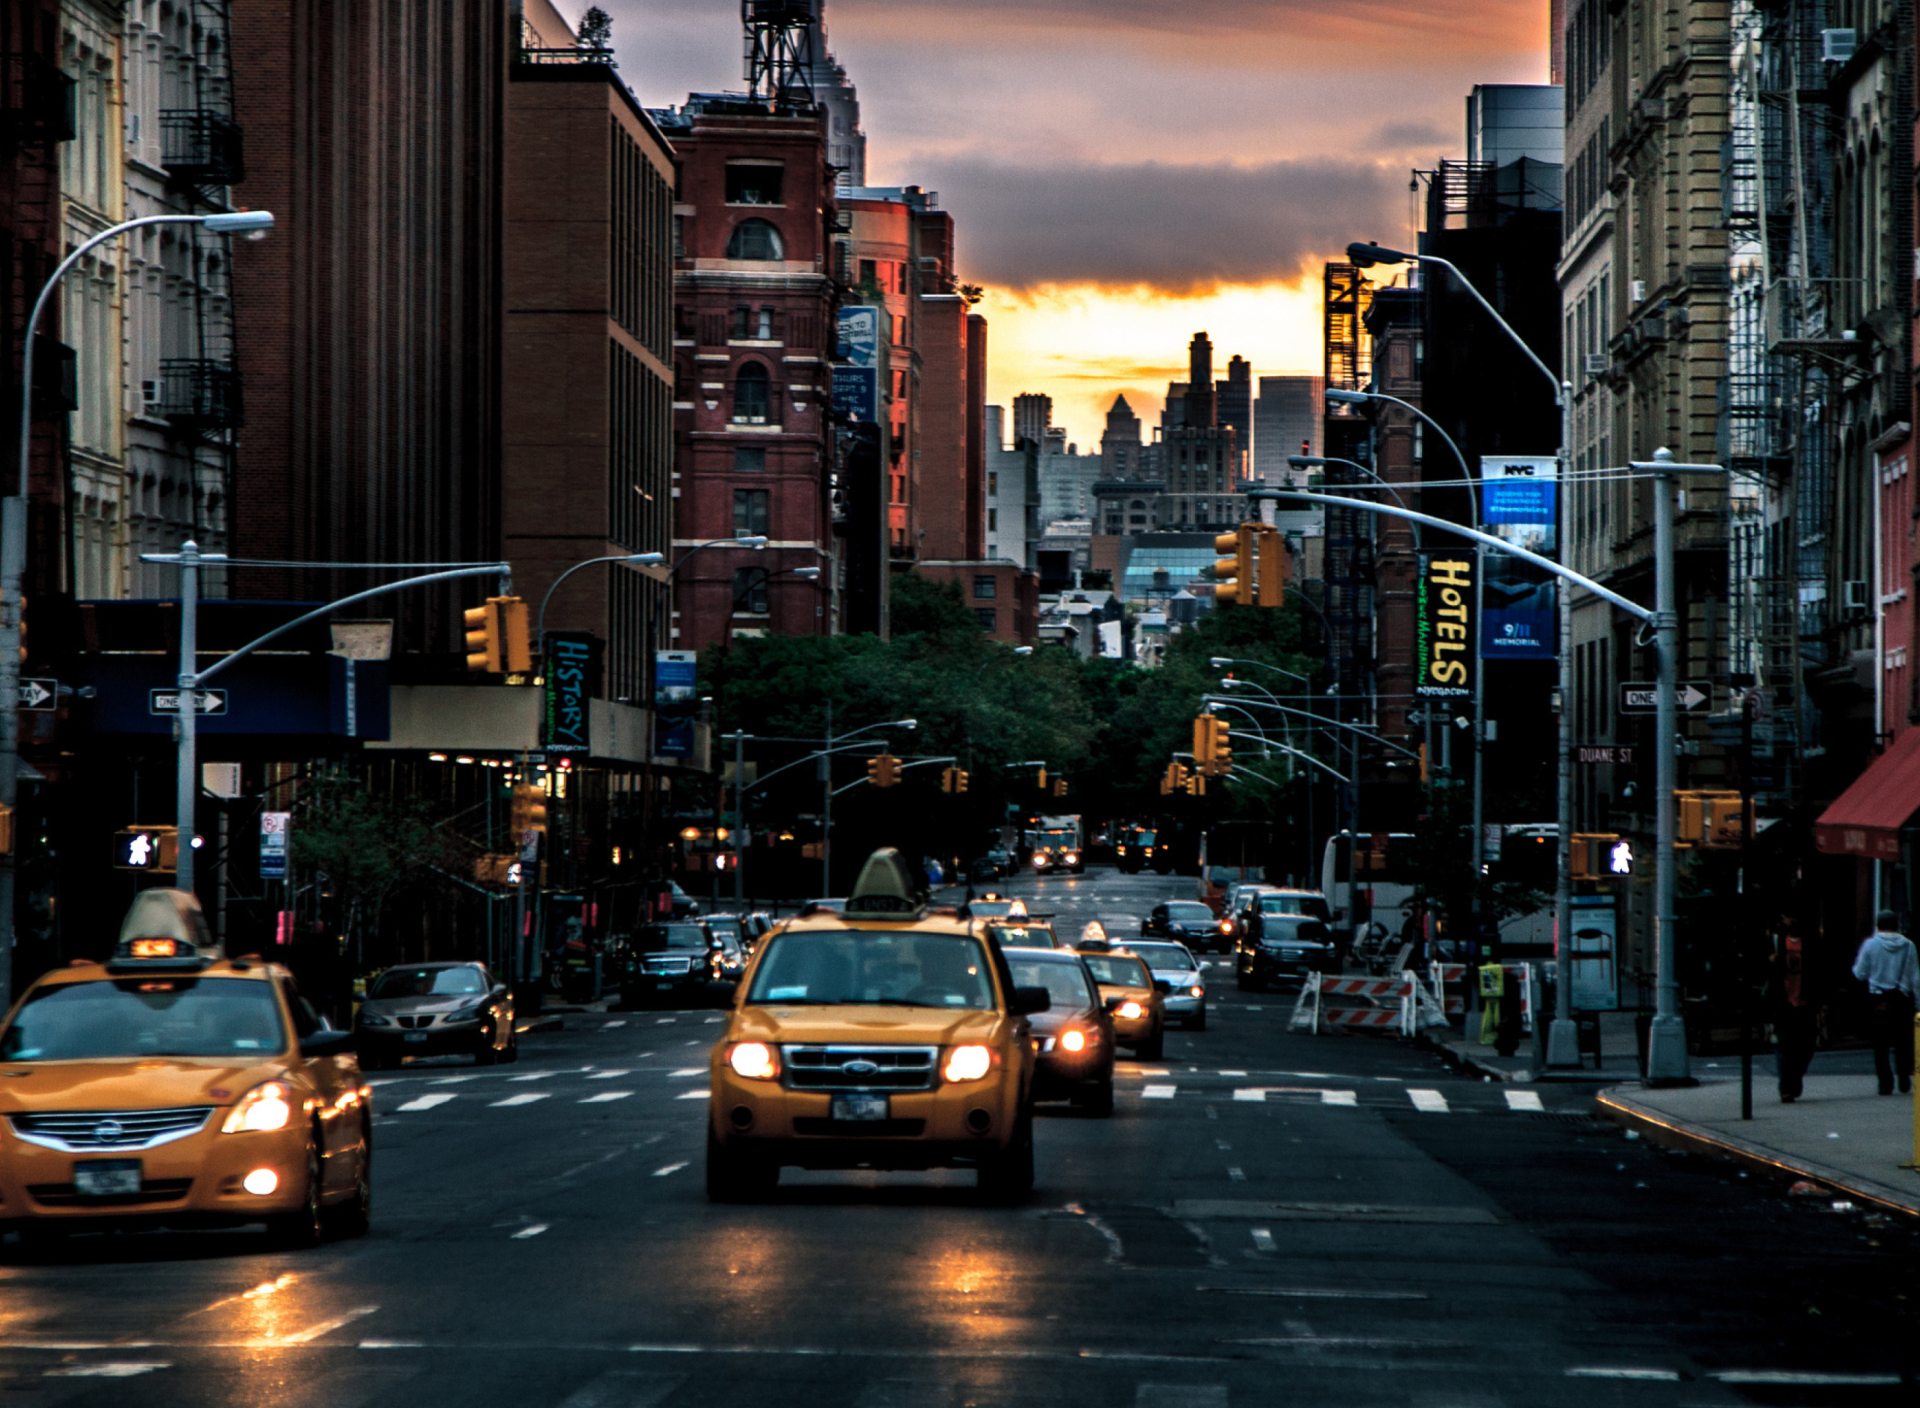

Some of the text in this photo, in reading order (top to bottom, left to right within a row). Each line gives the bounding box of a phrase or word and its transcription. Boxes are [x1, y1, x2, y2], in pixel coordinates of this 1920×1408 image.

[1504, 465, 1534, 475] NYC
[1503, 622, 1531, 638] 9/11
[1493, 638, 1541, 647] MEMORIAL
[159, 697, 179, 707] ONE
[1630, 692, 1655, 704] ONE
[1579, 747, 1633, 763] DUANE ST
